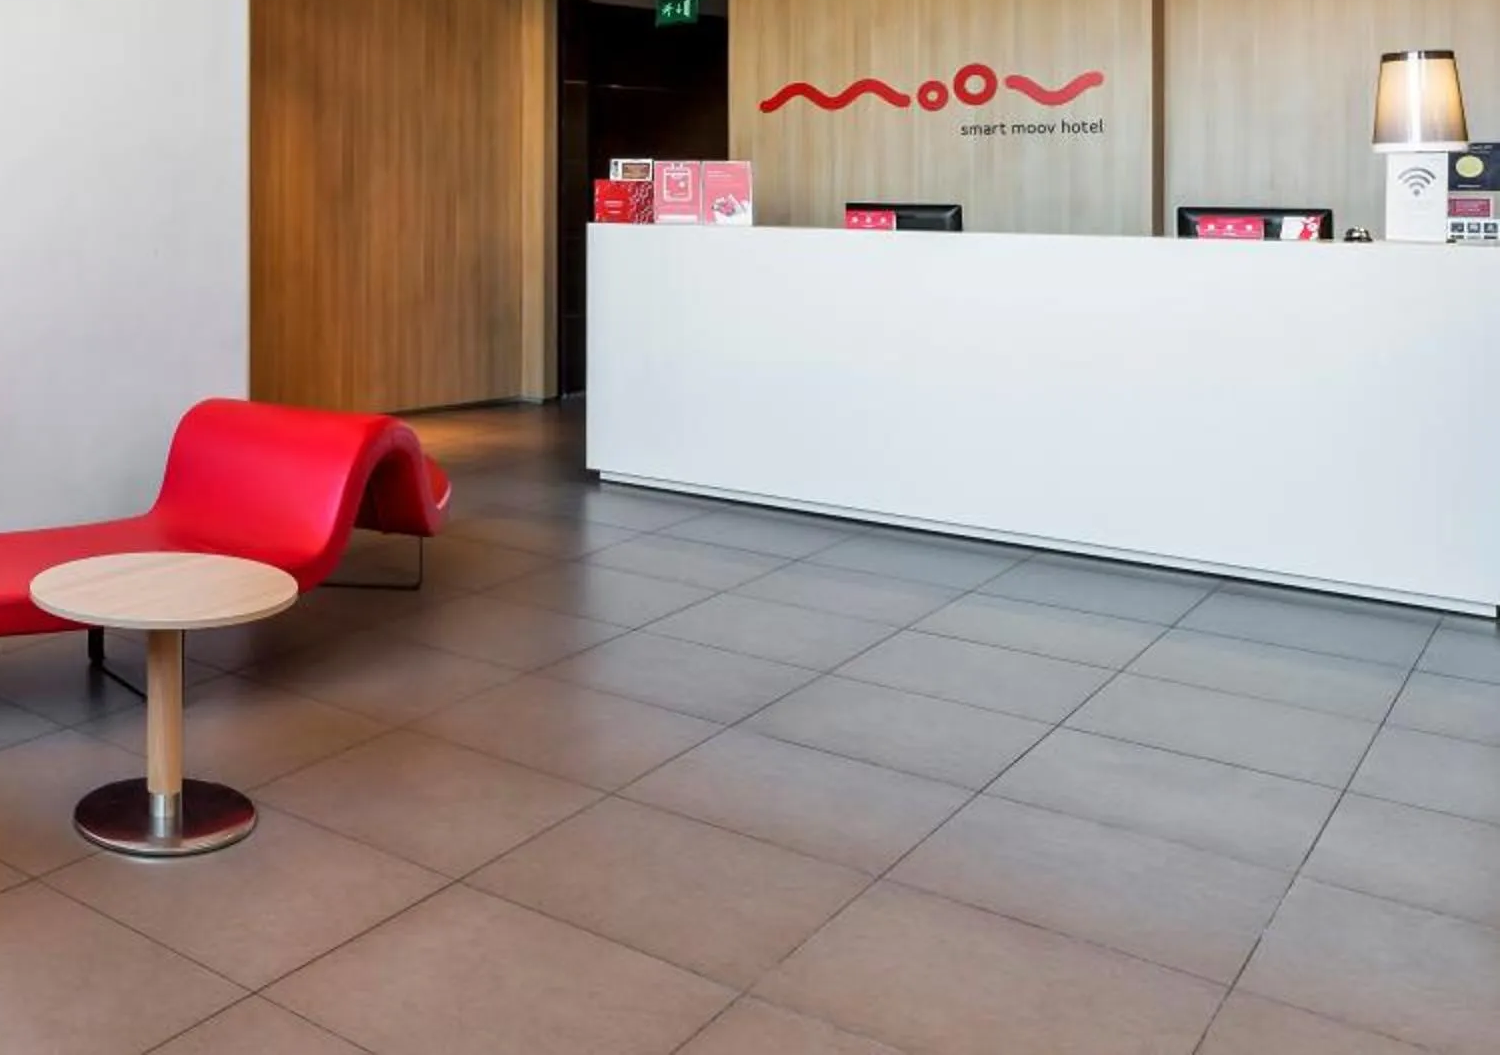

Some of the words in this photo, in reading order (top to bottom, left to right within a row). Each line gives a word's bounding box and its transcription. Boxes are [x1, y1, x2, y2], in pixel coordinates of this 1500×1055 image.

[960, 122, 1007, 136] smart
[1011, 123, 1056, 135] moov
[1061, 118, 1104, 134] hotel
